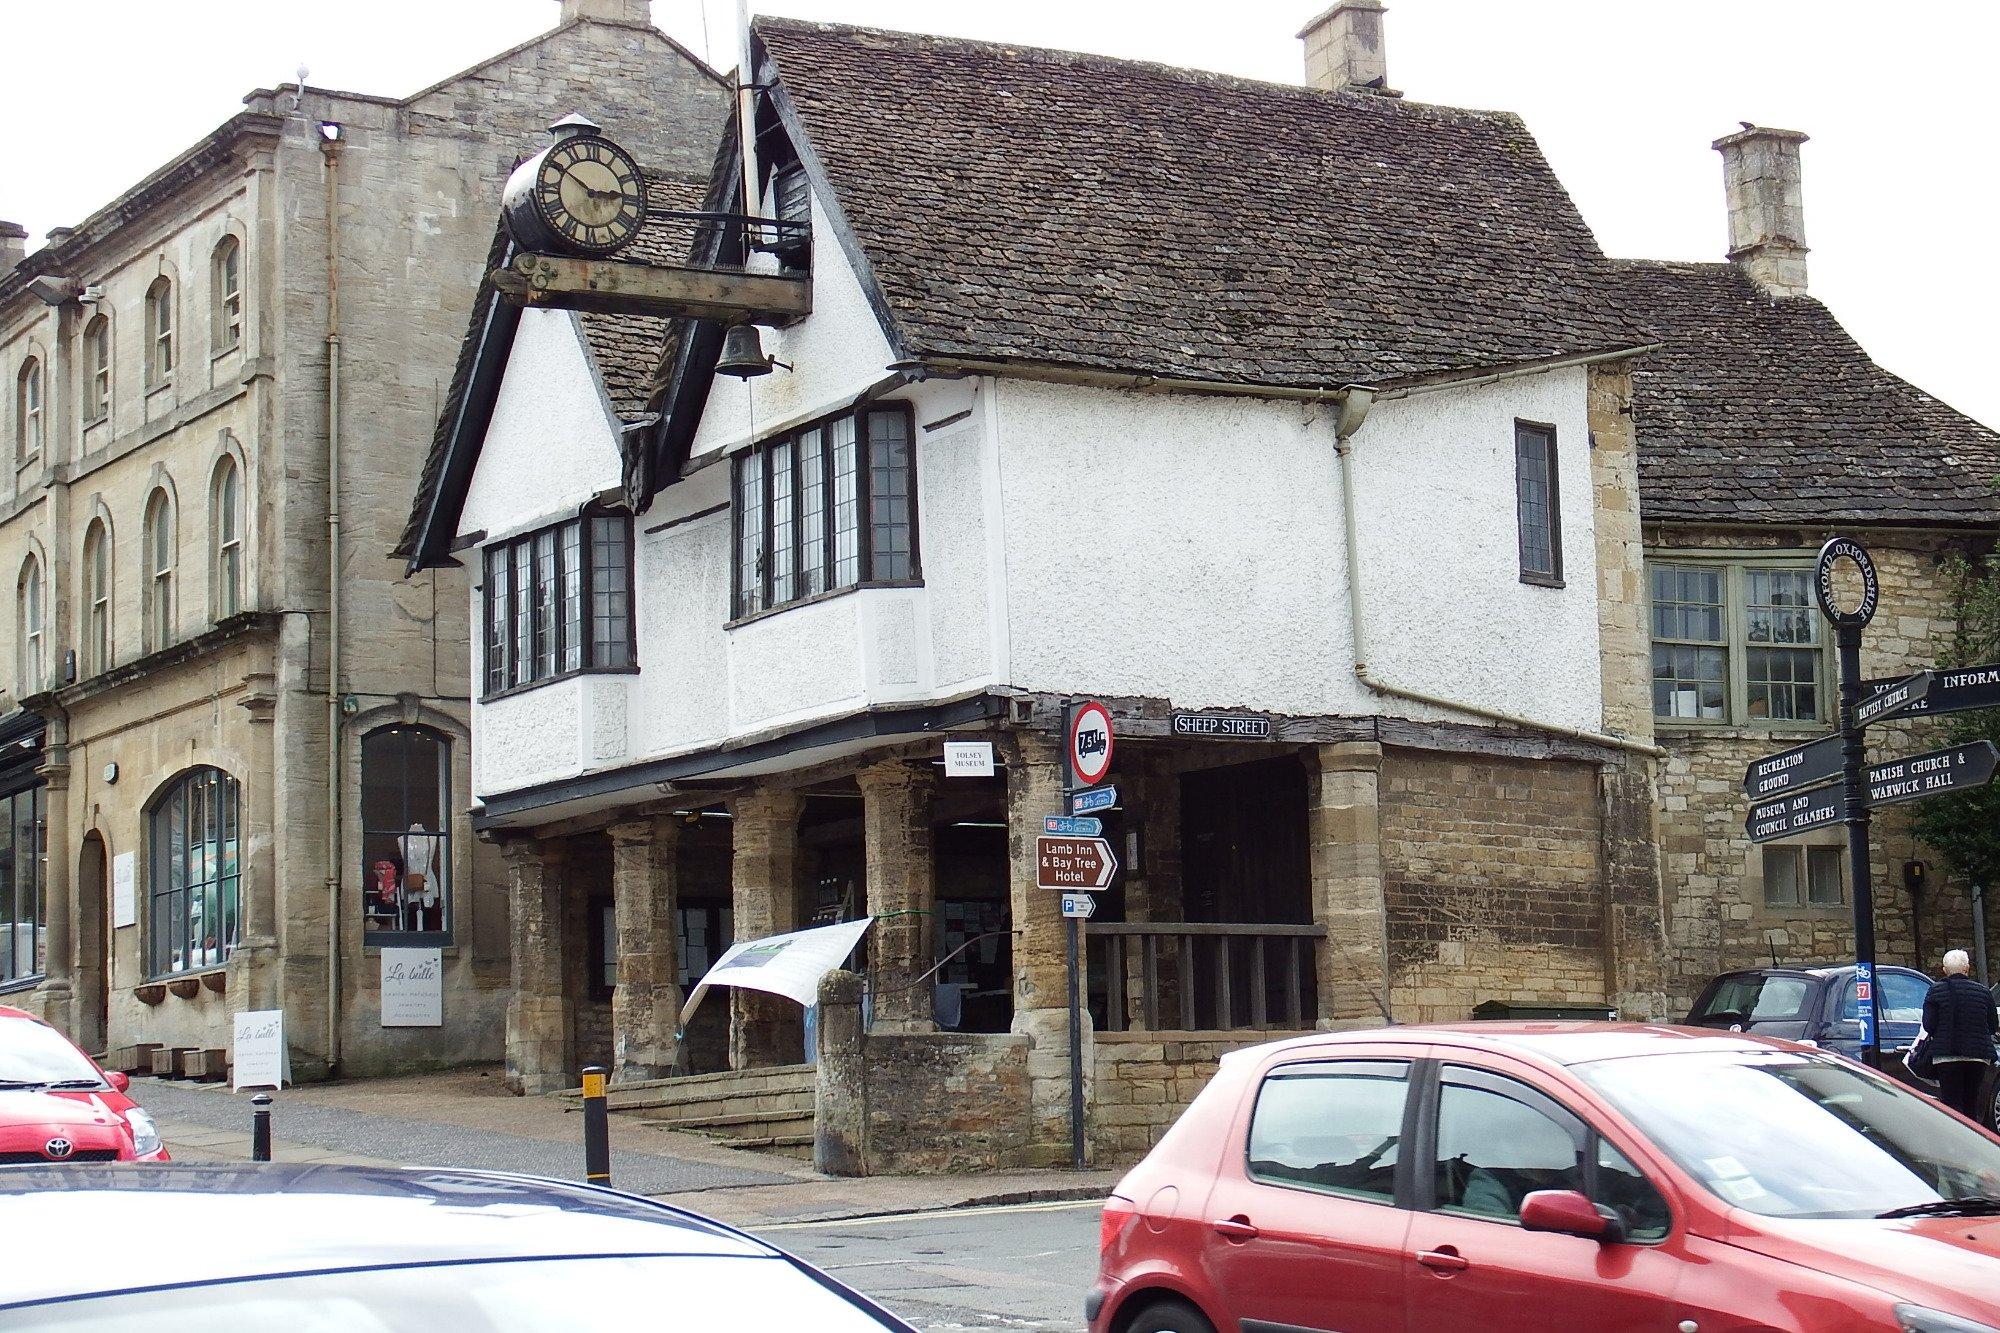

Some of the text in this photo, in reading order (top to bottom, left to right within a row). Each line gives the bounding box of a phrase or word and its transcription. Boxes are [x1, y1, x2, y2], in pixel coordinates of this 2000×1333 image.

[585, 144, 601, 161] XII
[585, 226, 600, 244] VI
[1858, 699, 1881, 720] BAPTIST
[1884, 686, 1908, 708] CHURCH
[1179, 717, 1267, 734] SHEEP STREET
[1758, 752, 1804, 776] RECREATION
[1869, 752, 1965, 783] PARISH CHURCH &
[1759, 773, 1789, 793] GROUND
[1870, 772, 1954, 800] WARWICK HALL
[1755, 796, 1809, 820] MUSEUM AND
[1756, 805, 1836, 837] COUNCIL CHAMBERS
[1046, 842, 1093, 855] Lamb Inn
[1042, 856, 1097, 870] & Bay Tree
[1055, 870, 1085, 882] Hotel
